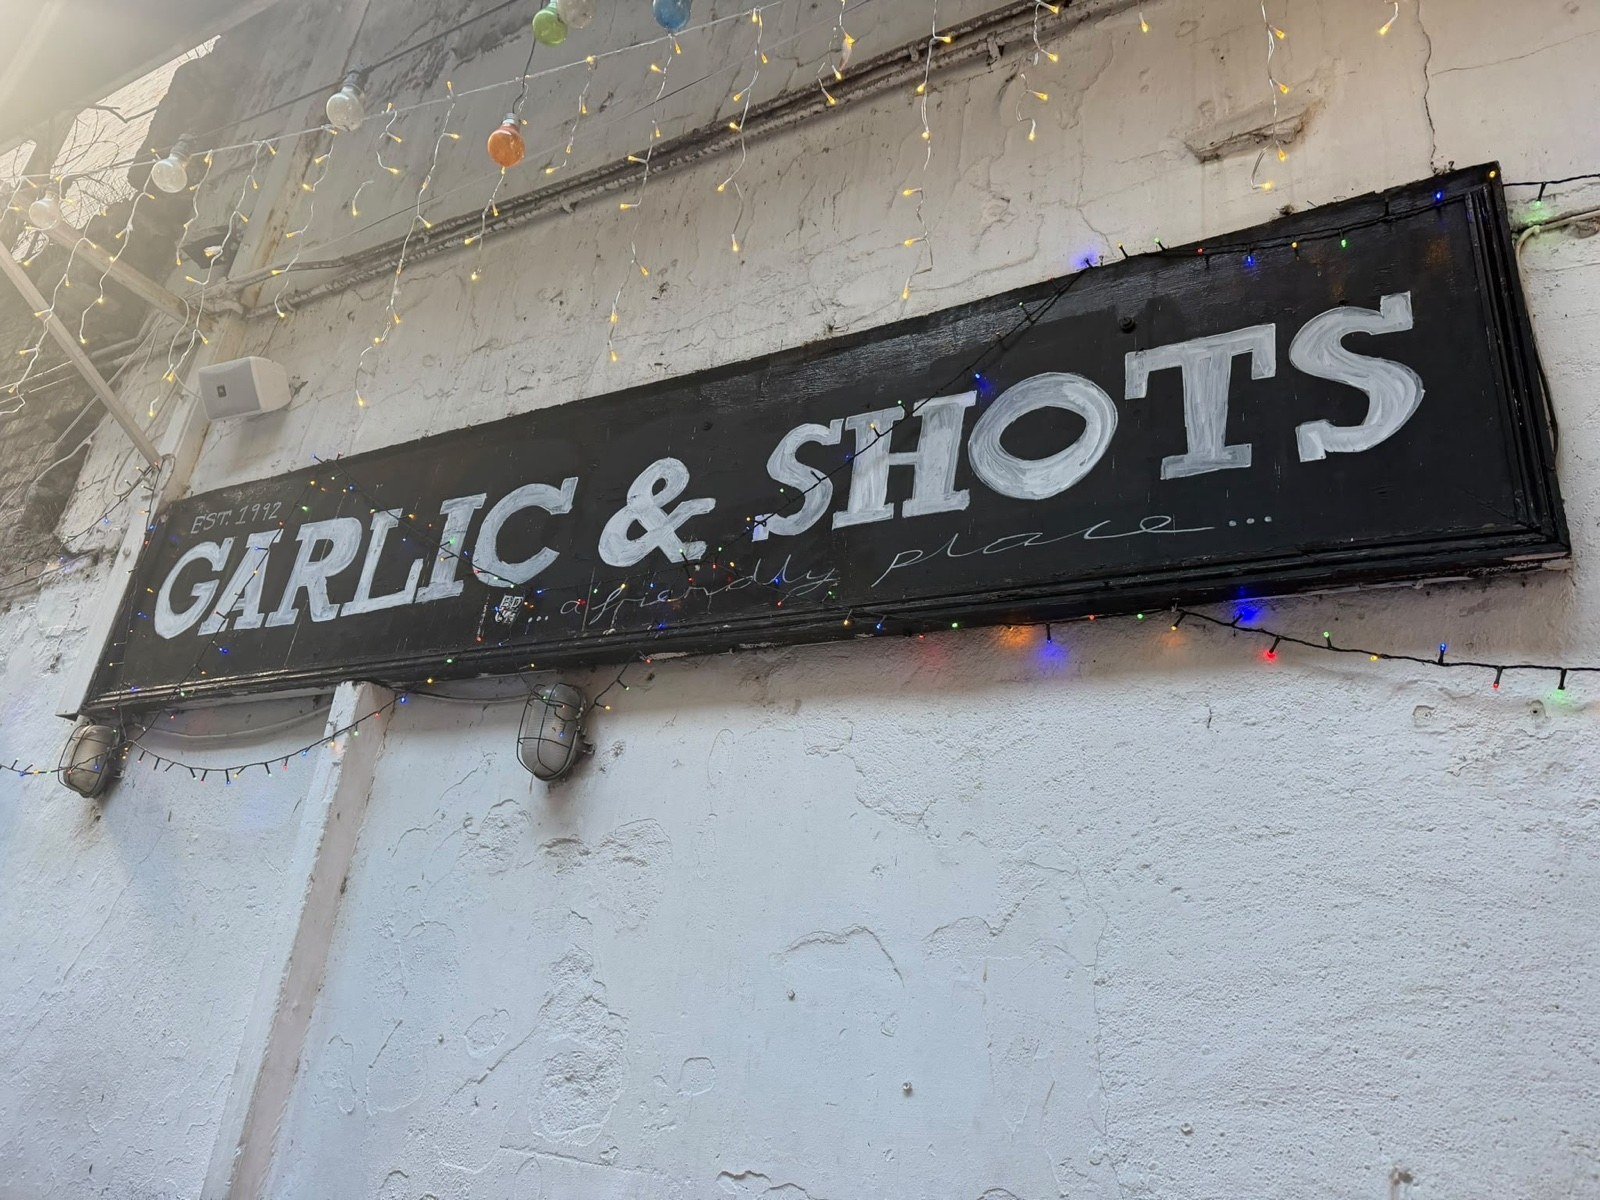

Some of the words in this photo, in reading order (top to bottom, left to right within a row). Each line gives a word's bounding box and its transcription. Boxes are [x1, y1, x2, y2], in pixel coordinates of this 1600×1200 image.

[153, 477, 578, 640] GARLIC
[598, 457, 717, 567] &
[752, 291, 1425, 542] SHOTS
[190, 510, 232, 534] EST.
[235, 501, 282, 525] 1992
